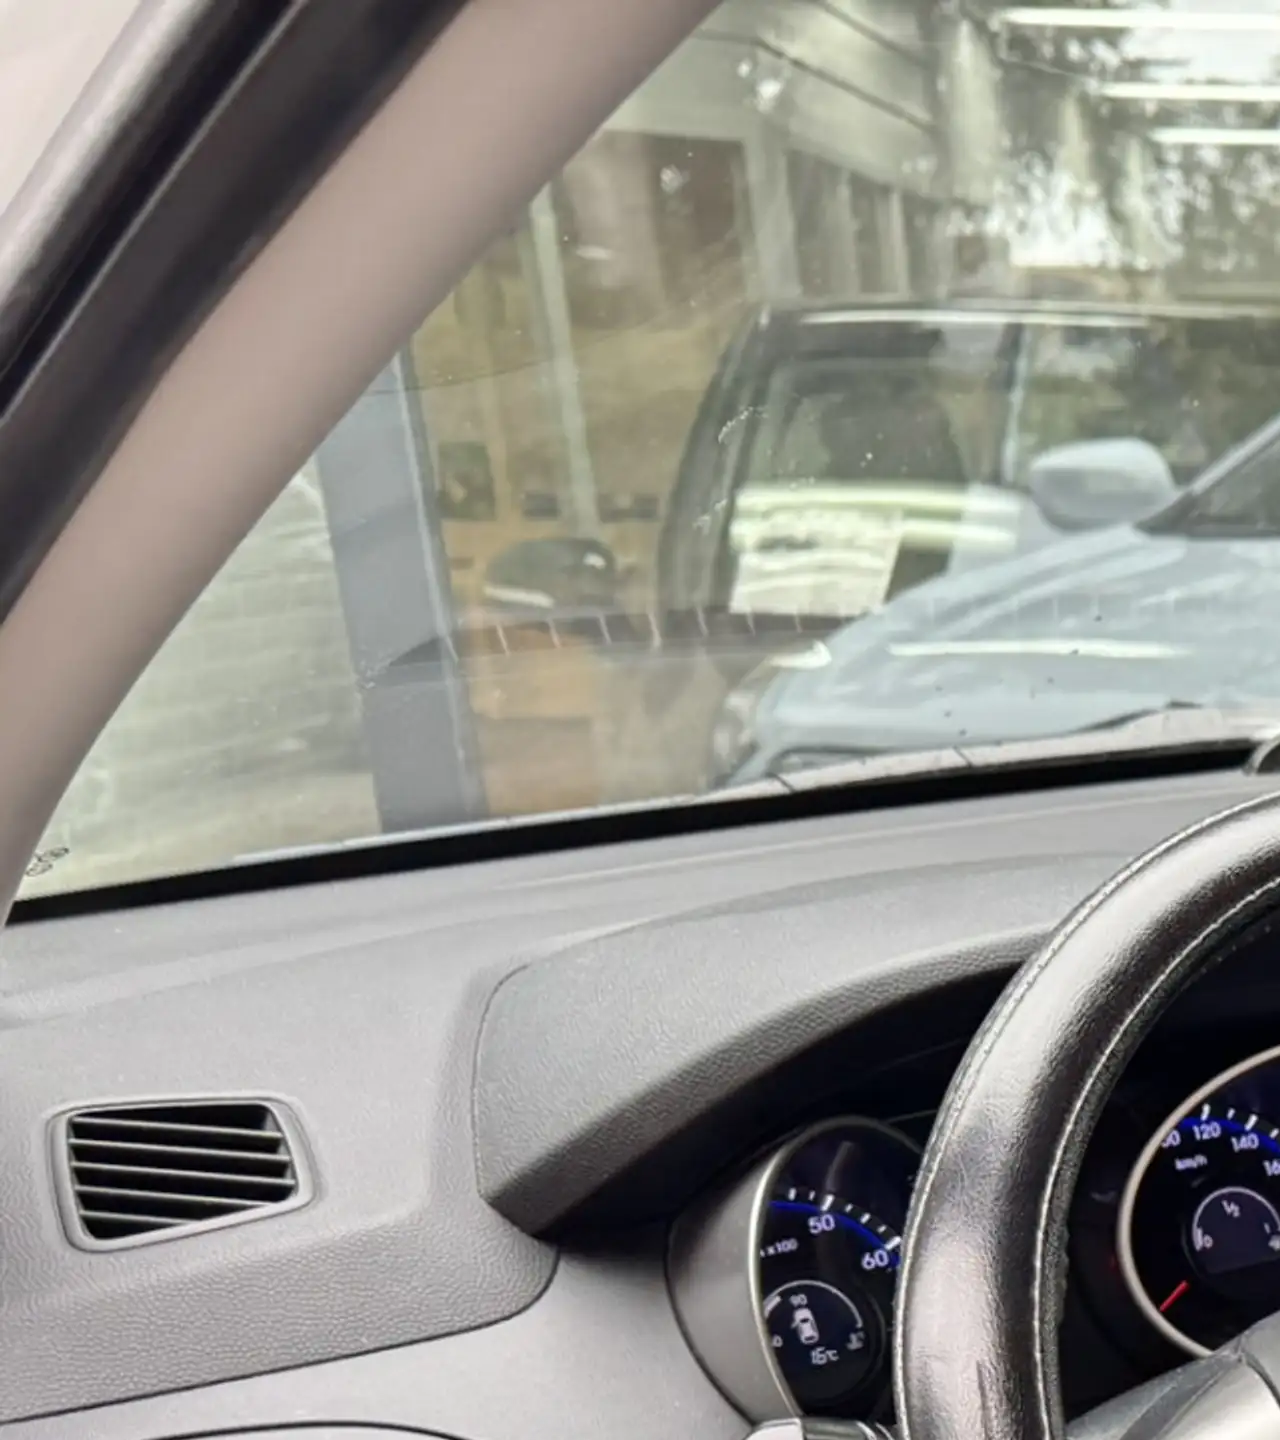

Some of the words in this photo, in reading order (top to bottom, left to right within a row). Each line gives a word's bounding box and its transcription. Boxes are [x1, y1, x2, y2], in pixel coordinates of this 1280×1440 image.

[1193, 1121, 1222, 1141] 120
[1231, 1133, 1260, 1153] 140
[808, 1213, 836, 1235] 50
[861, 1249, 889, 1271] 60
